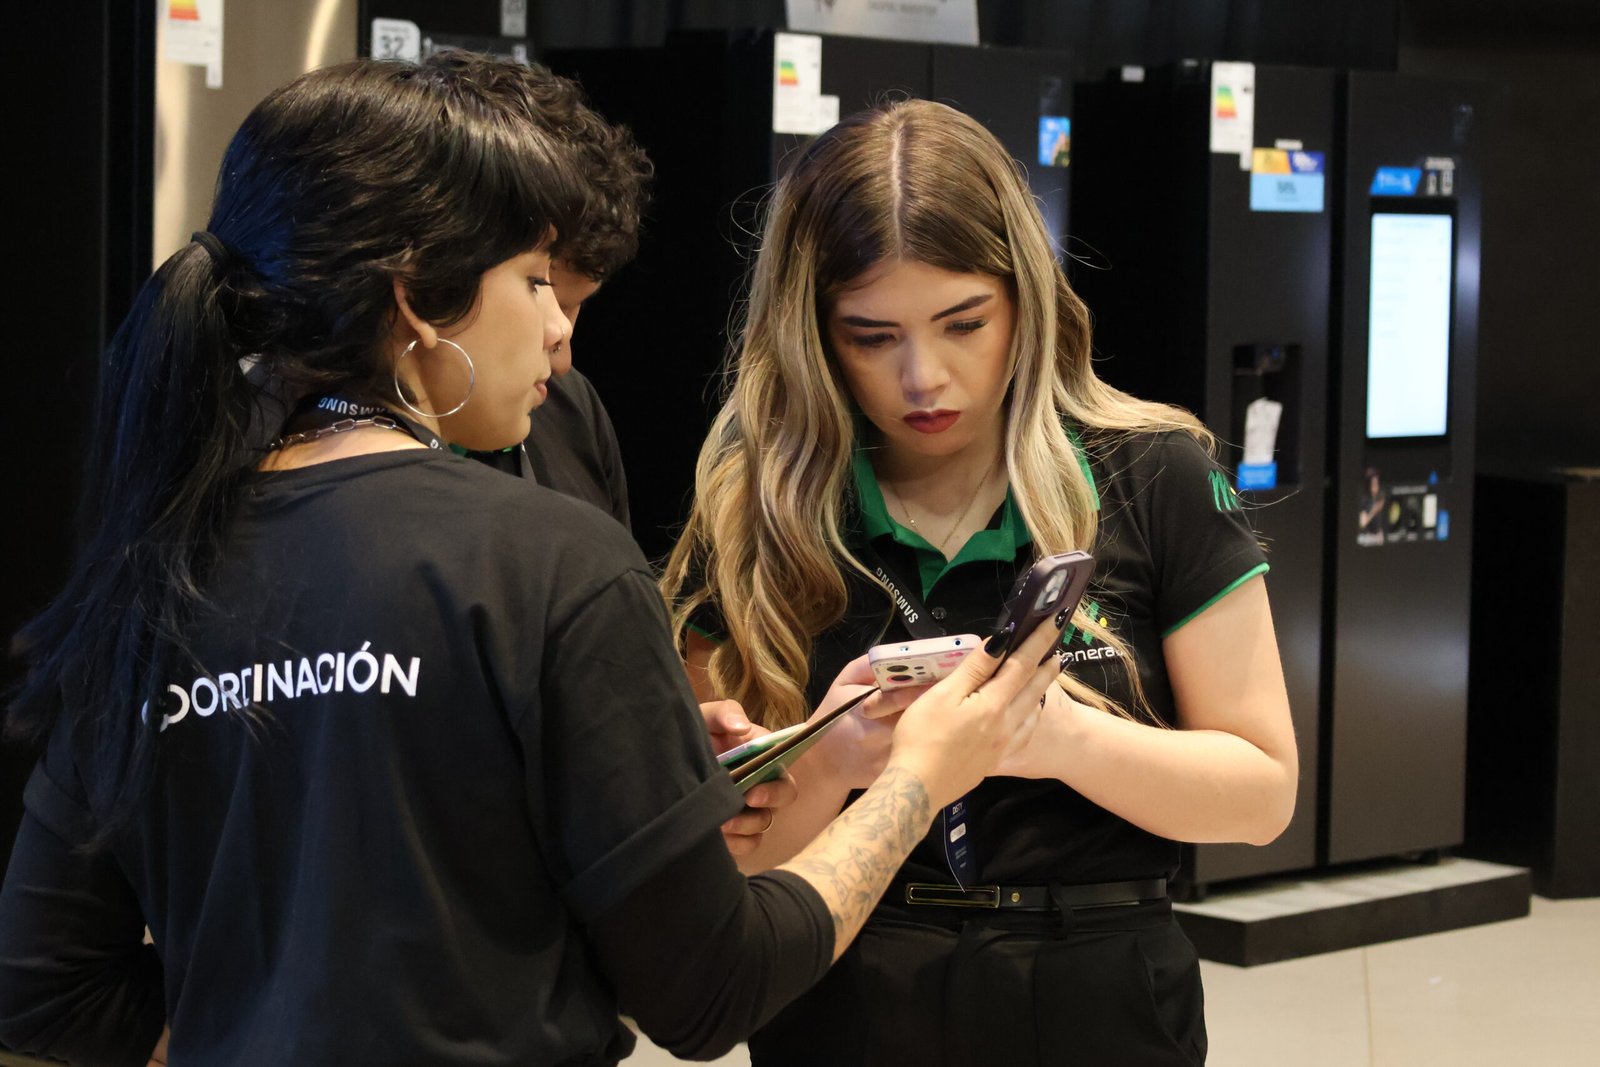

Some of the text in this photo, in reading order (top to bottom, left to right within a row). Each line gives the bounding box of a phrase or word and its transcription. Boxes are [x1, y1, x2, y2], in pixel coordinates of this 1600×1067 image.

[317, 397, 386, 416] MSUNG
[876, 567, 919, 624] SAMSUNG
[141, 640, 420, 732] OORINACIÓN
